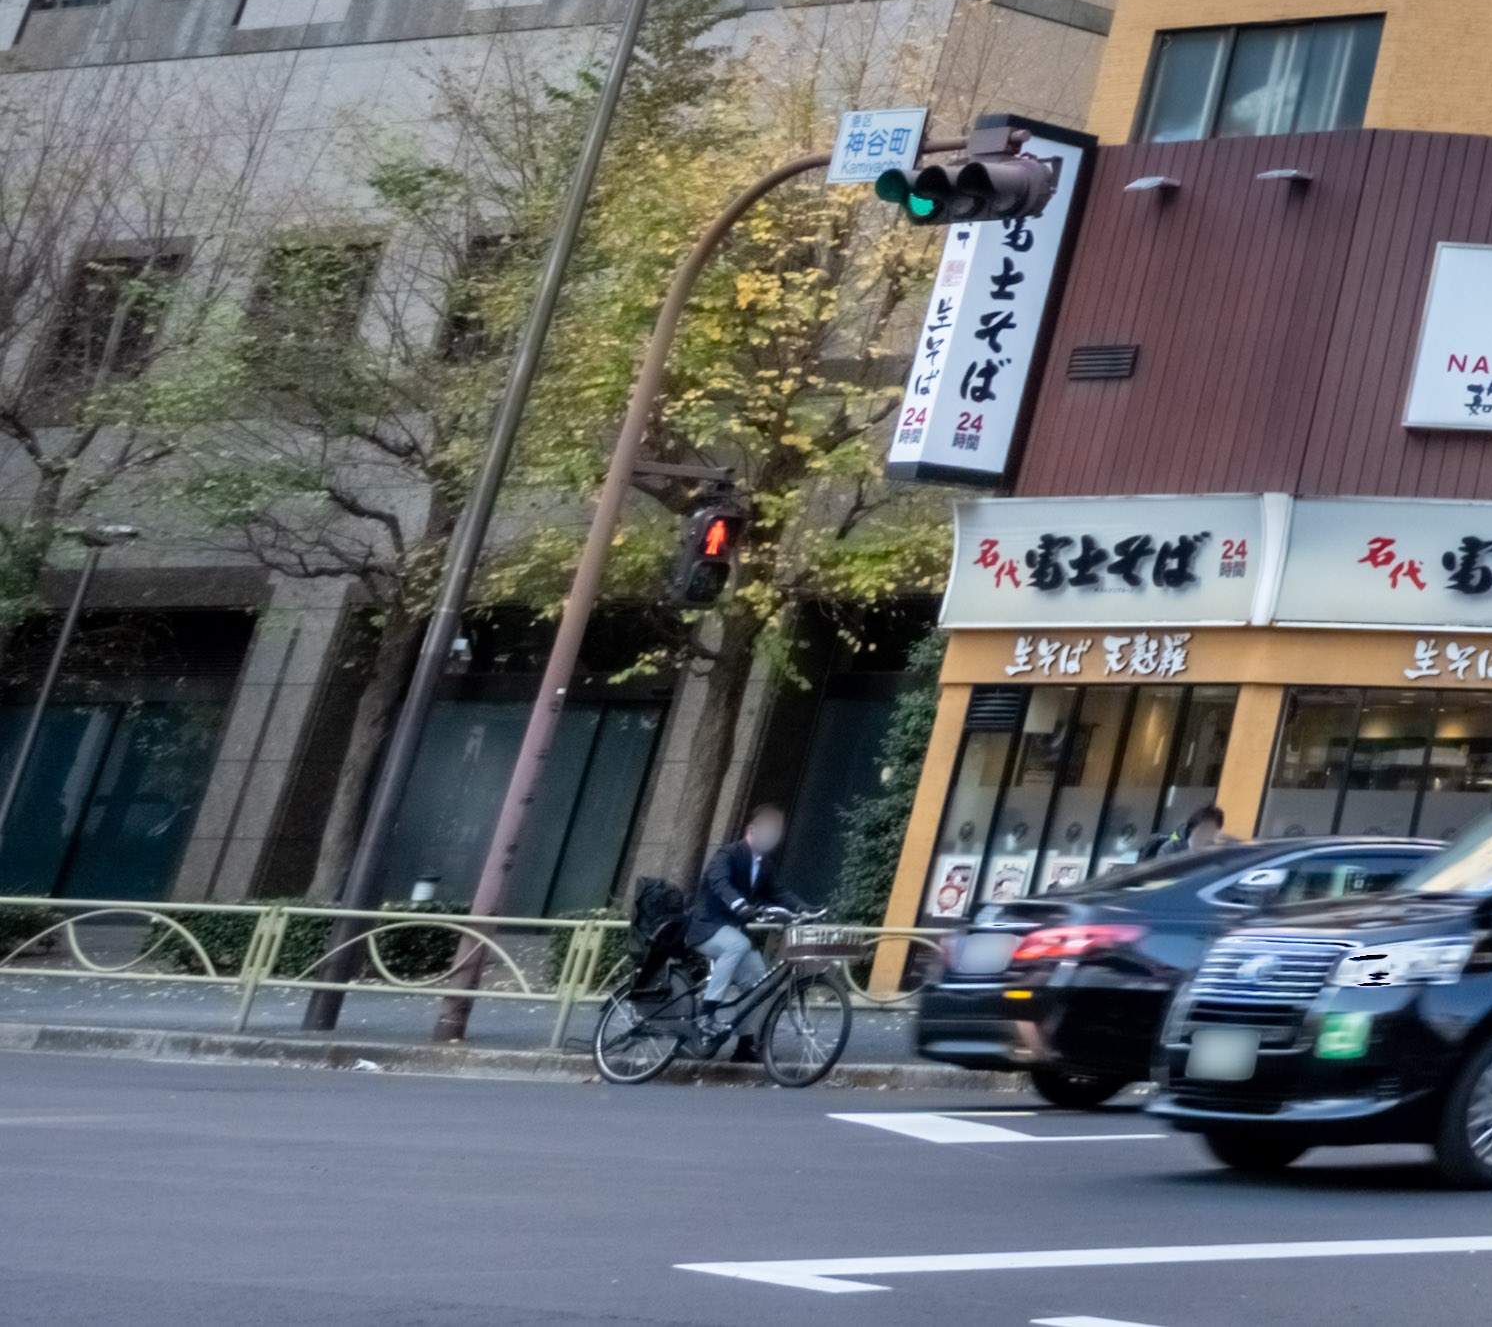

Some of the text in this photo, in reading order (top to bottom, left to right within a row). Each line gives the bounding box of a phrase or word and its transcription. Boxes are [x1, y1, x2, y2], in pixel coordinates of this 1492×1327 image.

[844, 128, 912, 158] 神谷町
[840, 159, 902, 175] Kamiyacho
[903, 407, 928, 427] 24
[956, 411, 984, 433] 24
[897, 427, 924, 445] 時間
[951, 432, 982, 452] 時間
[1221, 539, 1248, 560] 24
[973, 531, 1212, 591] 名代 富士そば
[1218, 560, 1247, 579] 時間
[1358, 536, 1428, 591] 名代
[1005, 635, 1093, 677] 生そば
